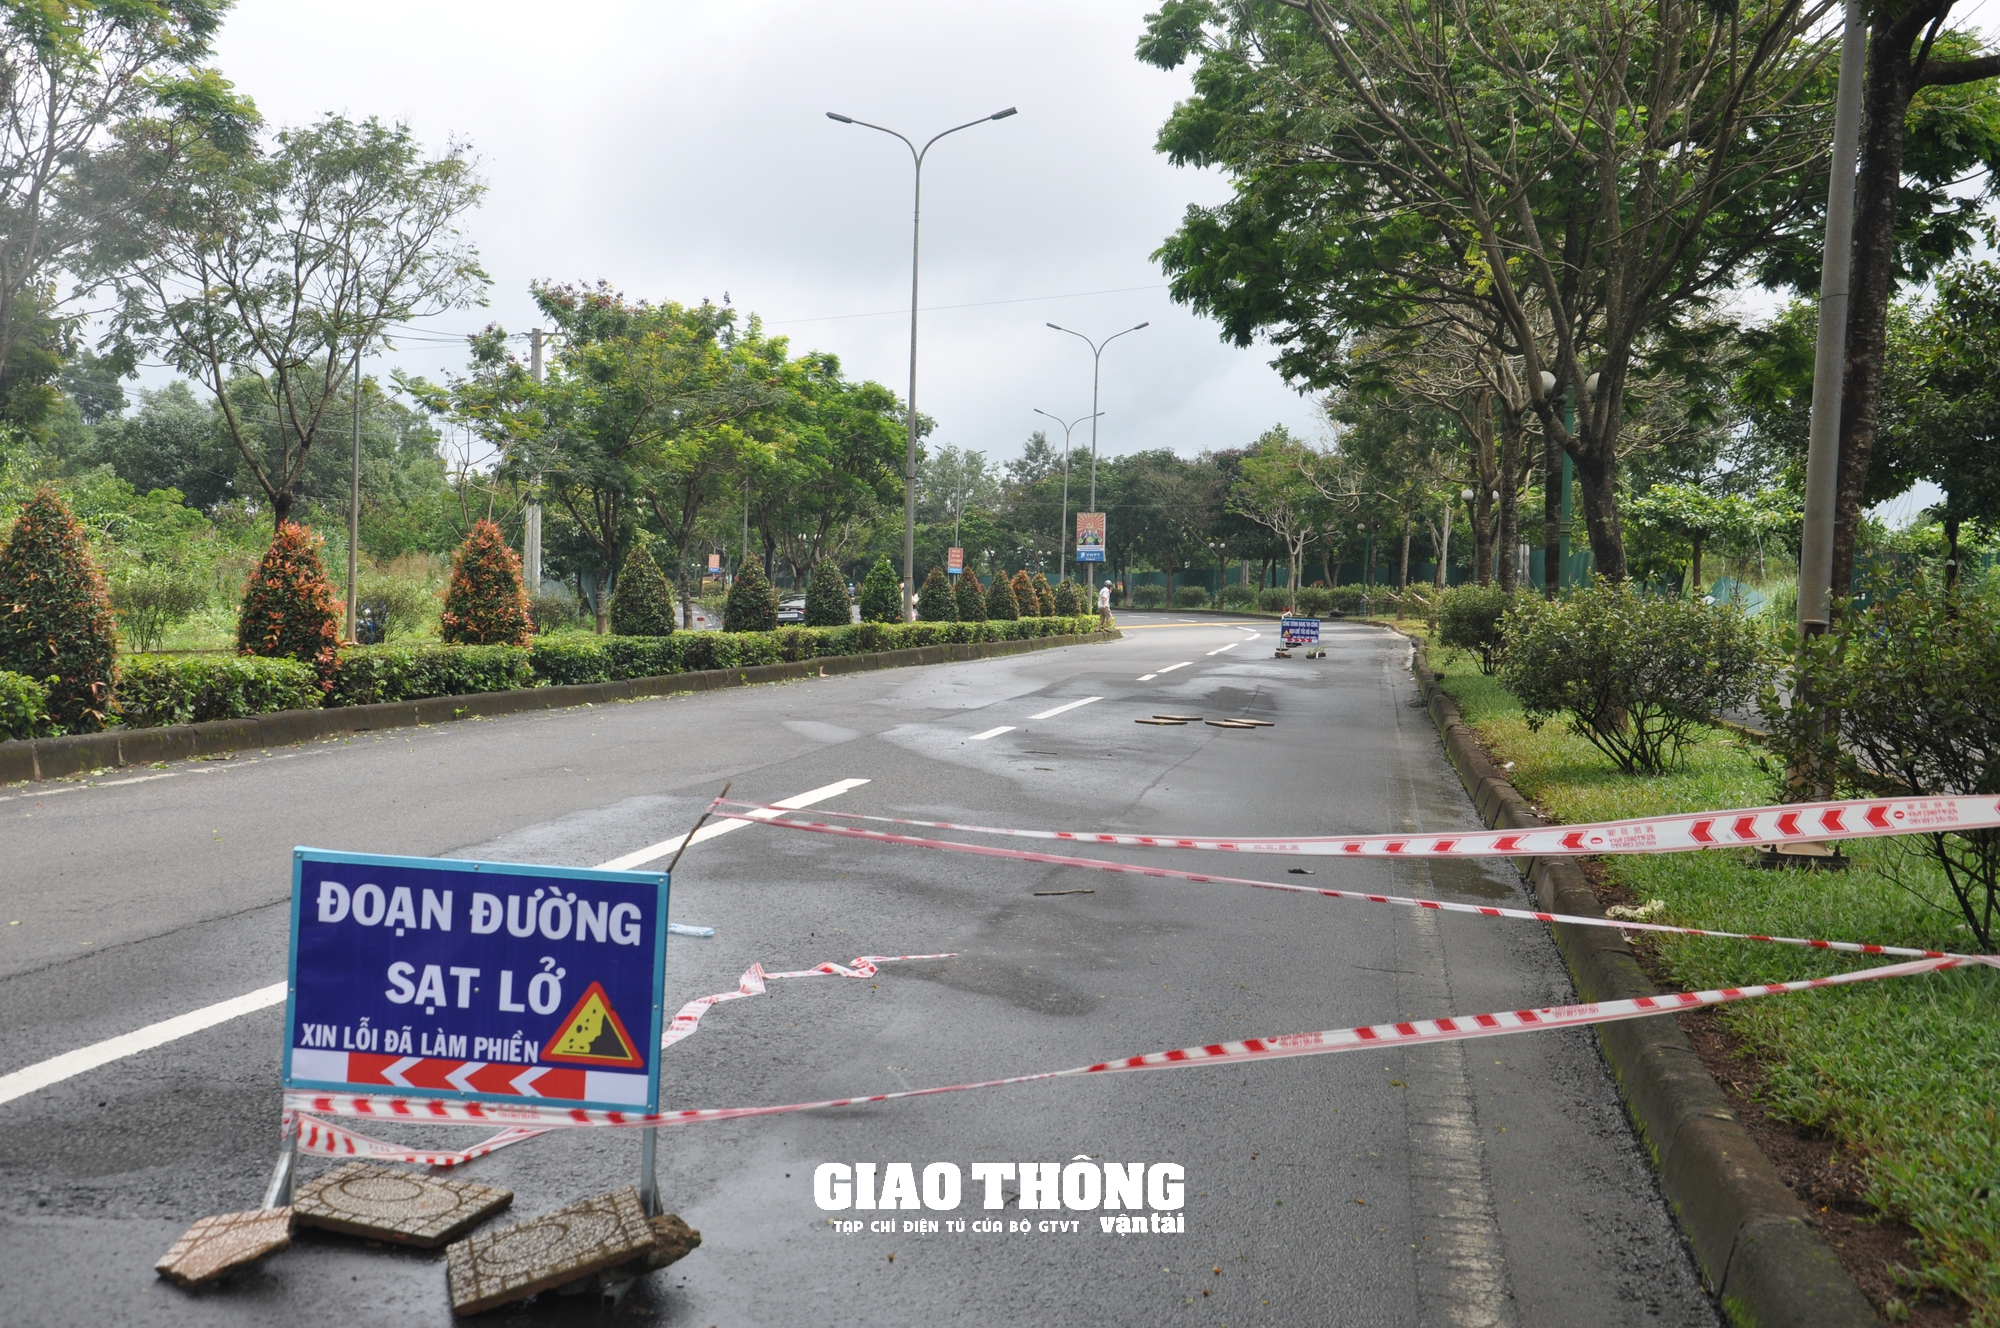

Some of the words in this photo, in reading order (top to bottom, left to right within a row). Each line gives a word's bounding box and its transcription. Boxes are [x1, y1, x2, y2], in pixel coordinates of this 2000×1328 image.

[317, 881, 453, 937] ĐOẠN
[469, 886, 642, 946] ĐƯỜNG
[385, 961, 480, 1014] SẠT
[499, 956, 566, 1015] LỞ
[301, 1023, 337, 1048] XIN
[343, 1017, 378, 1051] LỖI
[384, 1025, 413, 1054] ĐÃ
[421, 1028, 467, 1058] LÀM
[474, 1030, 539, 1064] PHIỀN
